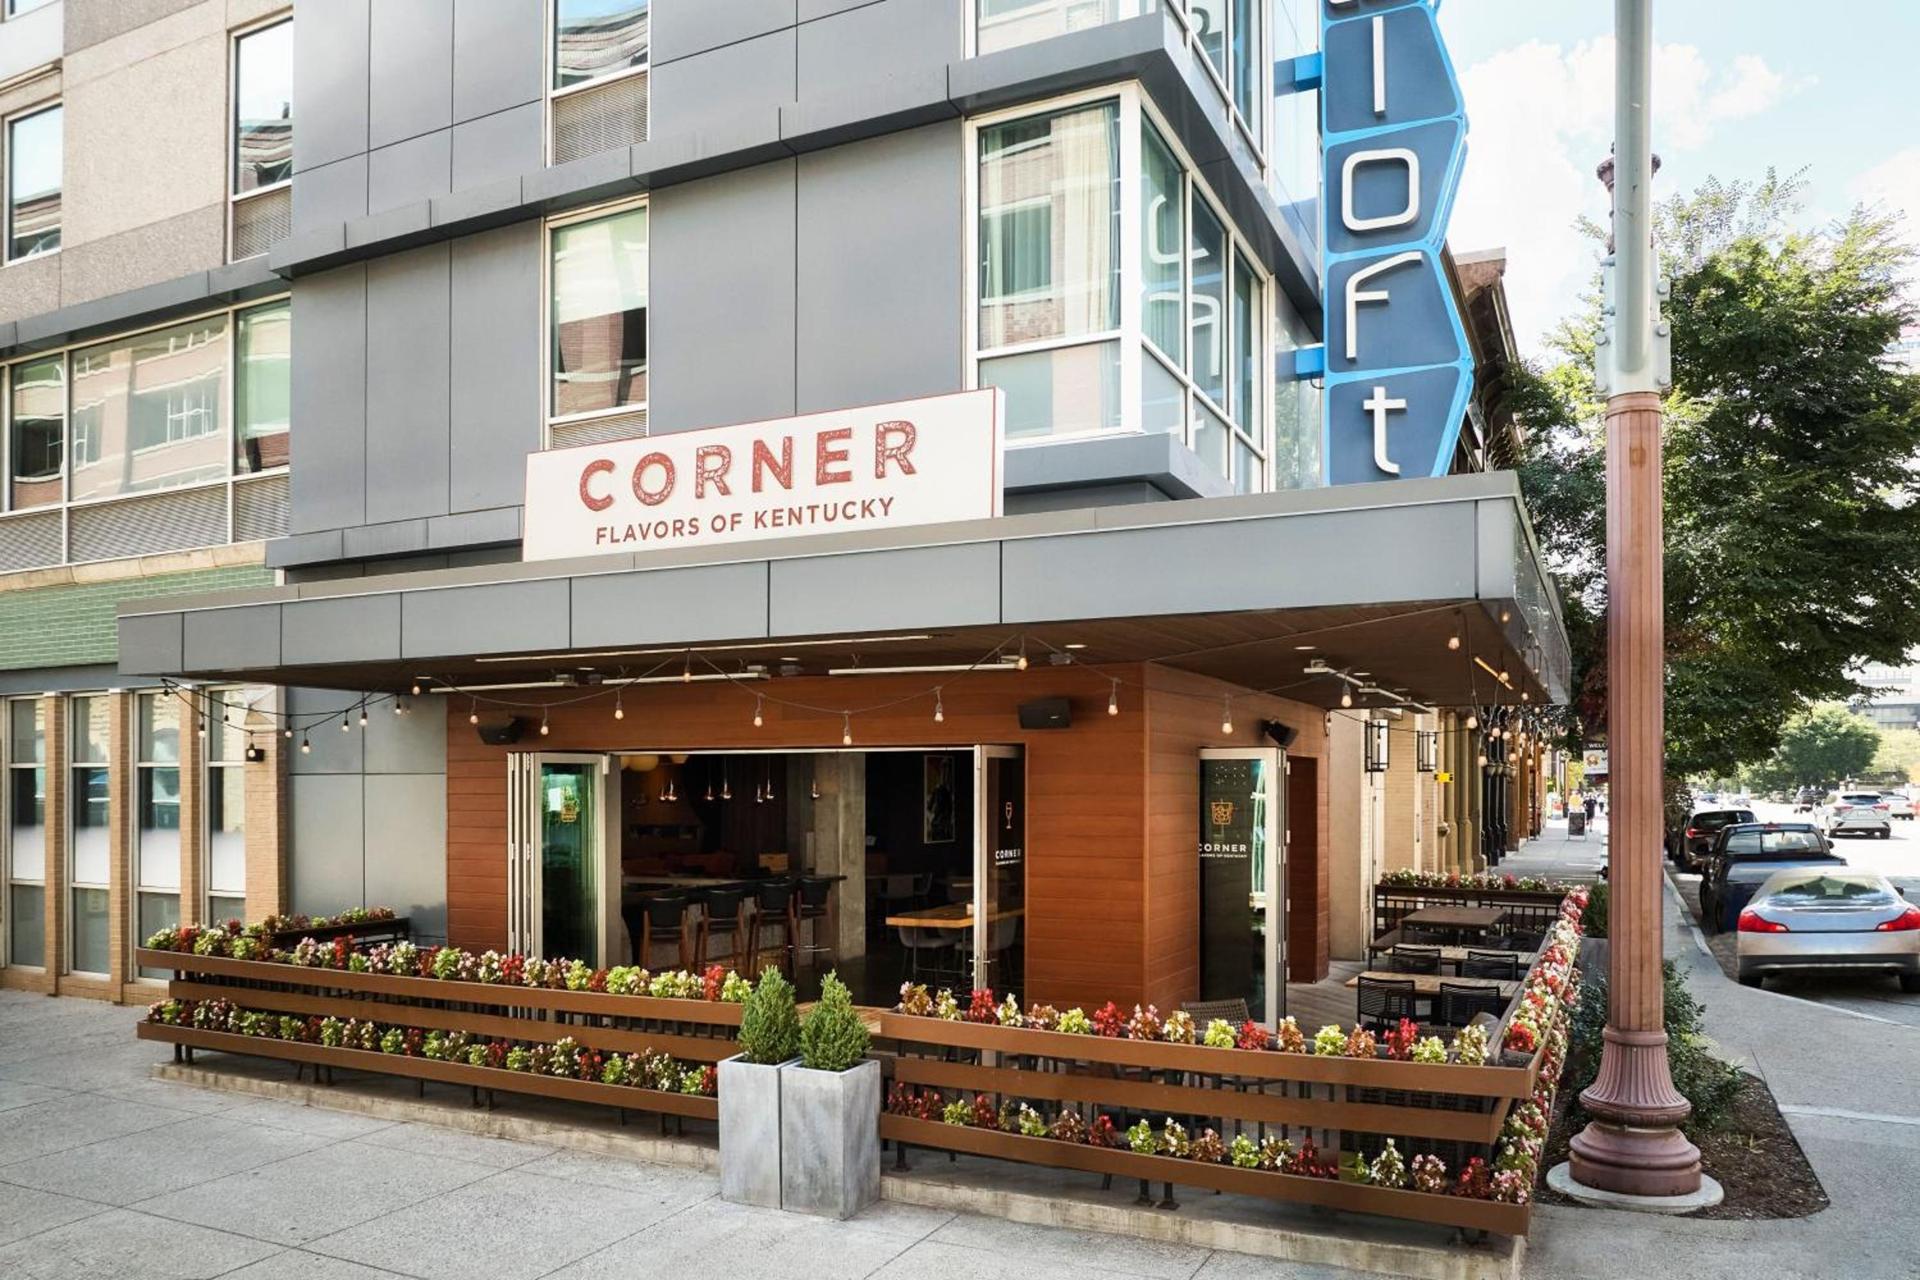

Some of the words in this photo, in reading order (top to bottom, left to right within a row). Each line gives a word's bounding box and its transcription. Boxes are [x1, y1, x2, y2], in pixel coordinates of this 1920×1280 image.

[1329, 0, 1422, 474] loft
[579, 420, 917, 512] CORNER
[596, 517, 700, 545] FLAVORS
[711, 512, 743, 533] OF
[754, 496, 894, 529] KENTUCKY
